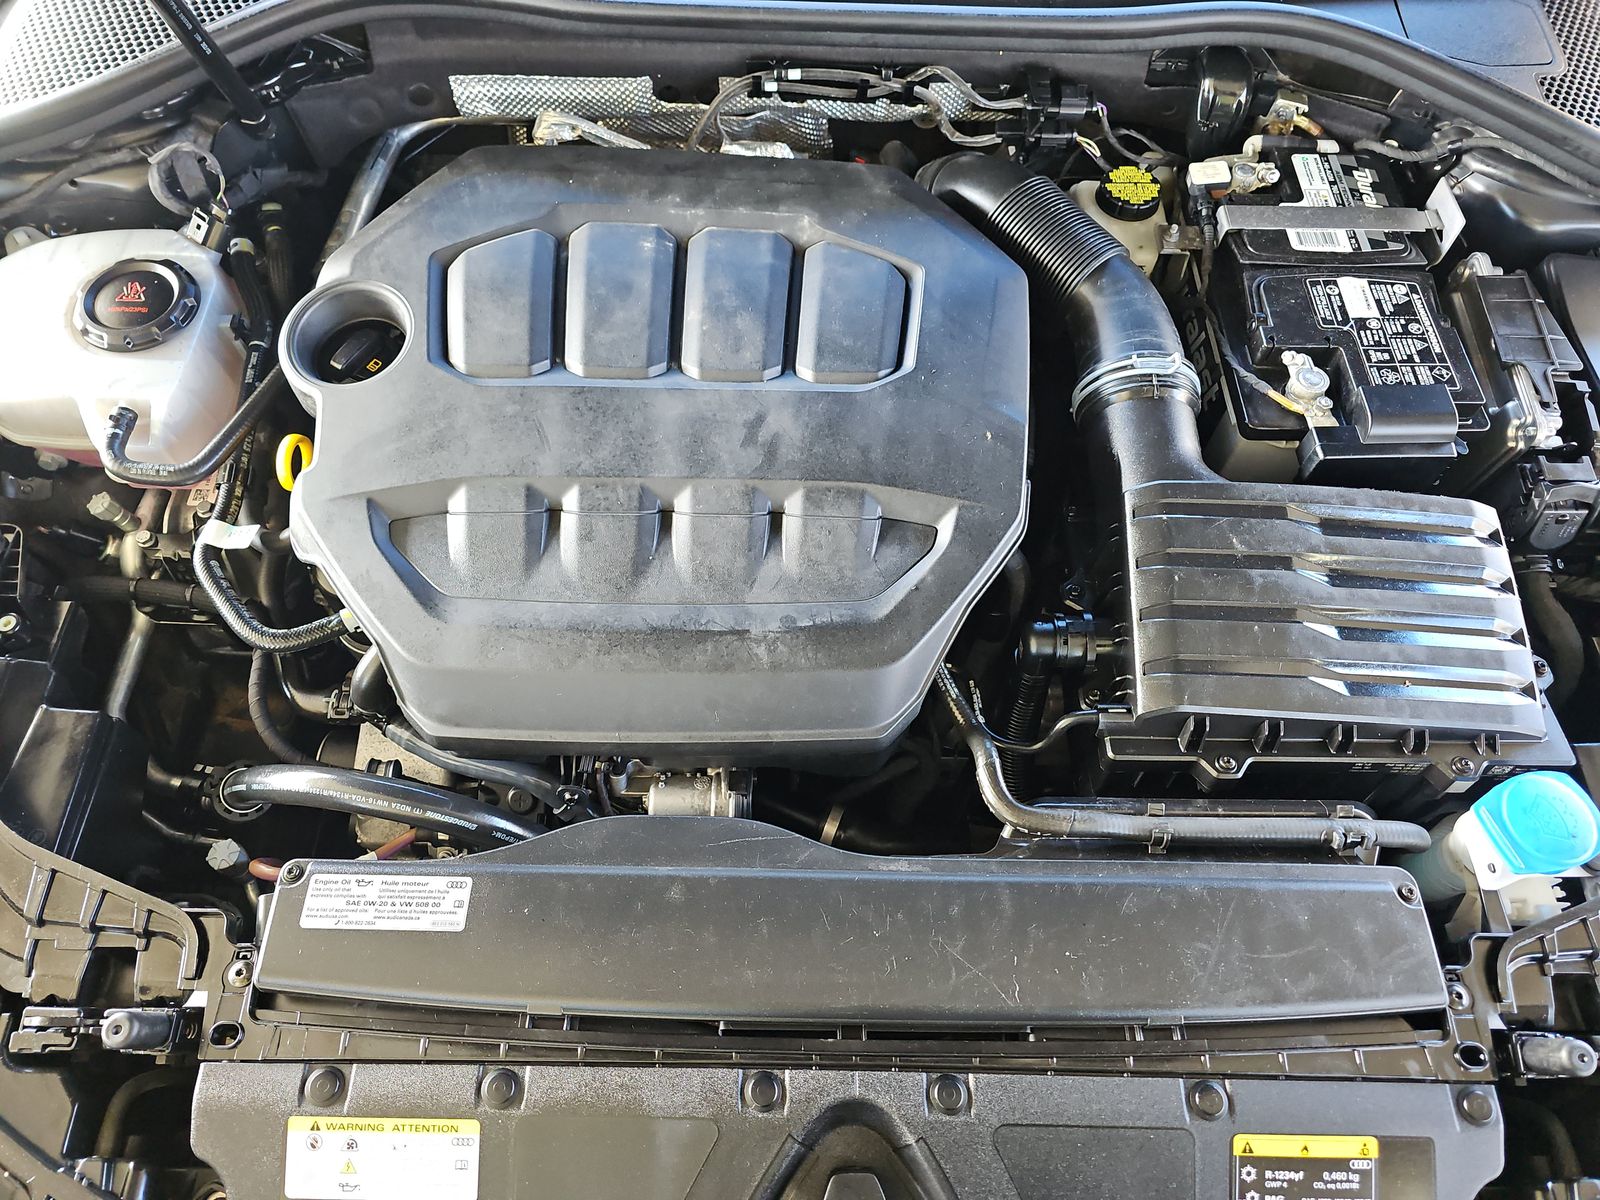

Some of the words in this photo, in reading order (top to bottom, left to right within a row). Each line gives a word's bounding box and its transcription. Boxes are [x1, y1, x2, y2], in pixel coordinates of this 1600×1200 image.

[424, 810, 479, 831] BRIDGESTONE
[314, 878, 339, 886] Engine
[325, 1122, 385, 1132] WARNING
[392, 1123, 459, 1133] ATTENTION
[1264, 1170, 1304, 1181] R-1234yf
[1348, 1172, 1360, 1182] kg
[1264, 1180, 1282, 1188] GWP
